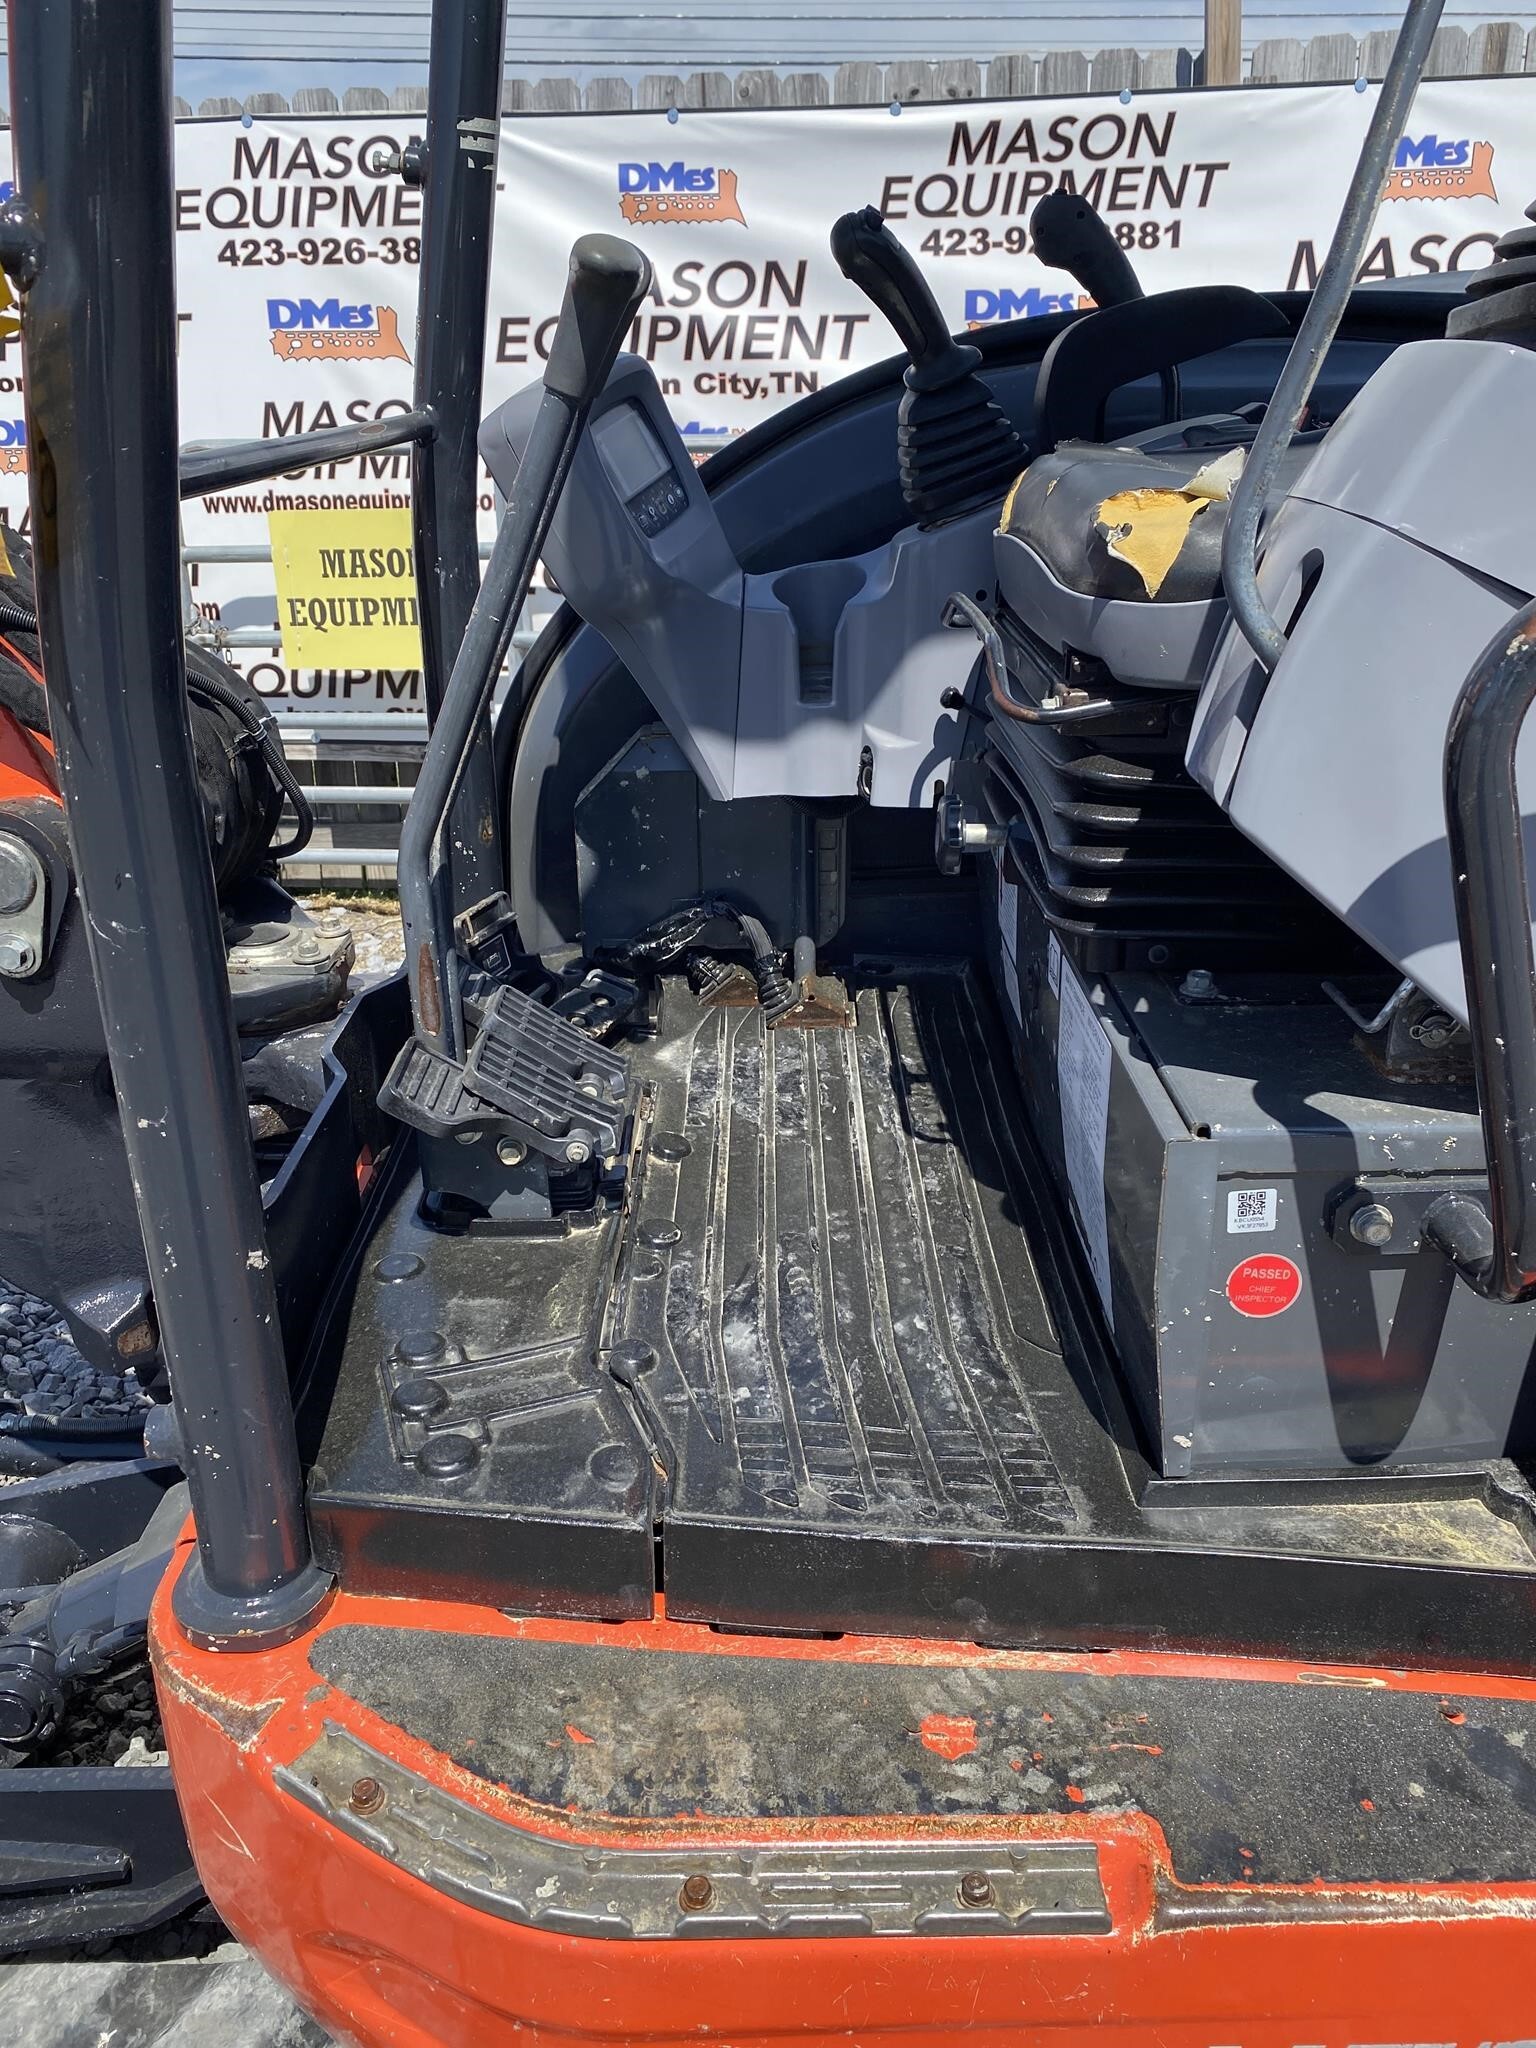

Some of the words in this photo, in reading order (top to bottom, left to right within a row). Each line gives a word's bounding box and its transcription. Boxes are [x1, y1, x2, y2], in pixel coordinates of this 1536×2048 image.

[947, 111, 1177, 167] MASON
[233, 135, 424, 181] MASO
[176, 185, 421, 230] EQUIPME
[880, 162, 1231, 220] EQUIPMENT
[217, 237, 421, 266] 423-926-38
[1242, 1267, 1292, 1280] PASSED
[1248, 1284, 1277, 1293] CHIEF
[1234, 1294, 1288, 1304] INSPECTOR
